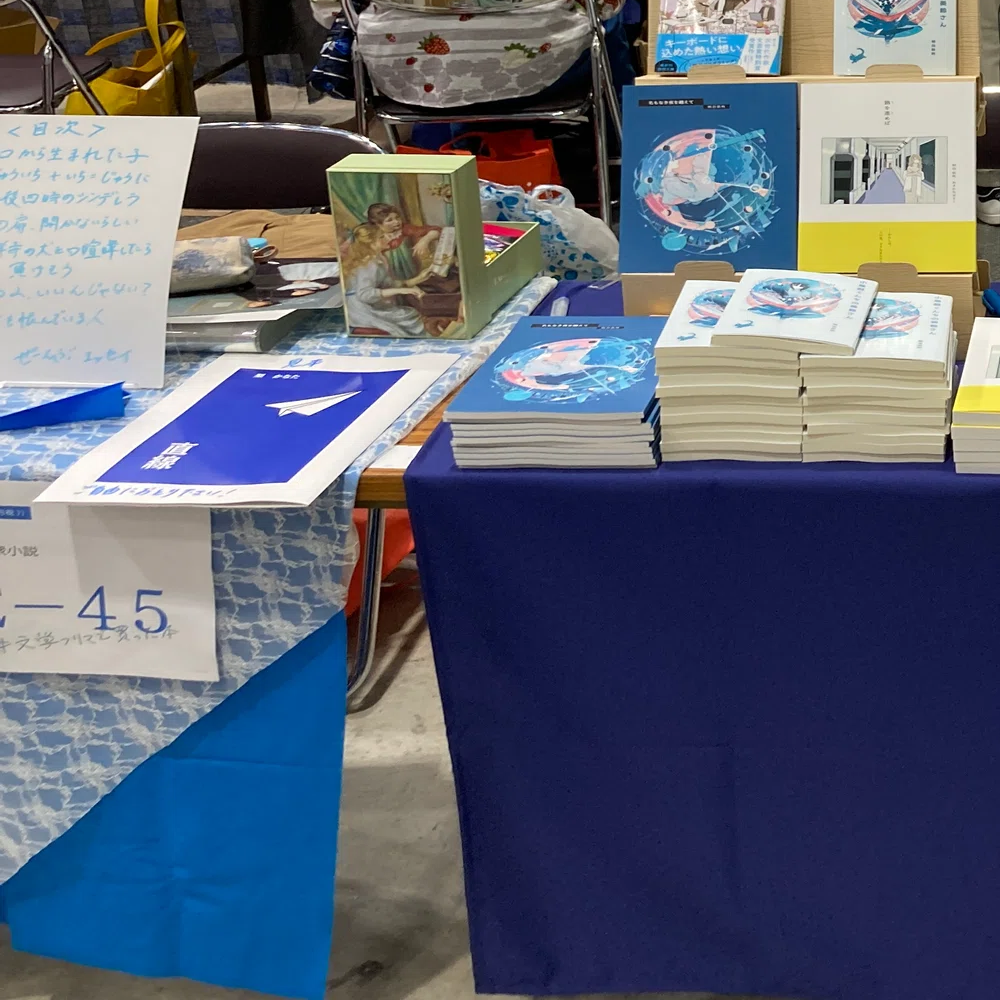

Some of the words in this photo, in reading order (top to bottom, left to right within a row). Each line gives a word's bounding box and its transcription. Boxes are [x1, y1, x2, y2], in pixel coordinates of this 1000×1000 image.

[665, 36, 728, 48] キーボードに
[140, 441, 199, 471] 直線
[0, 585, 169, 634] －45
